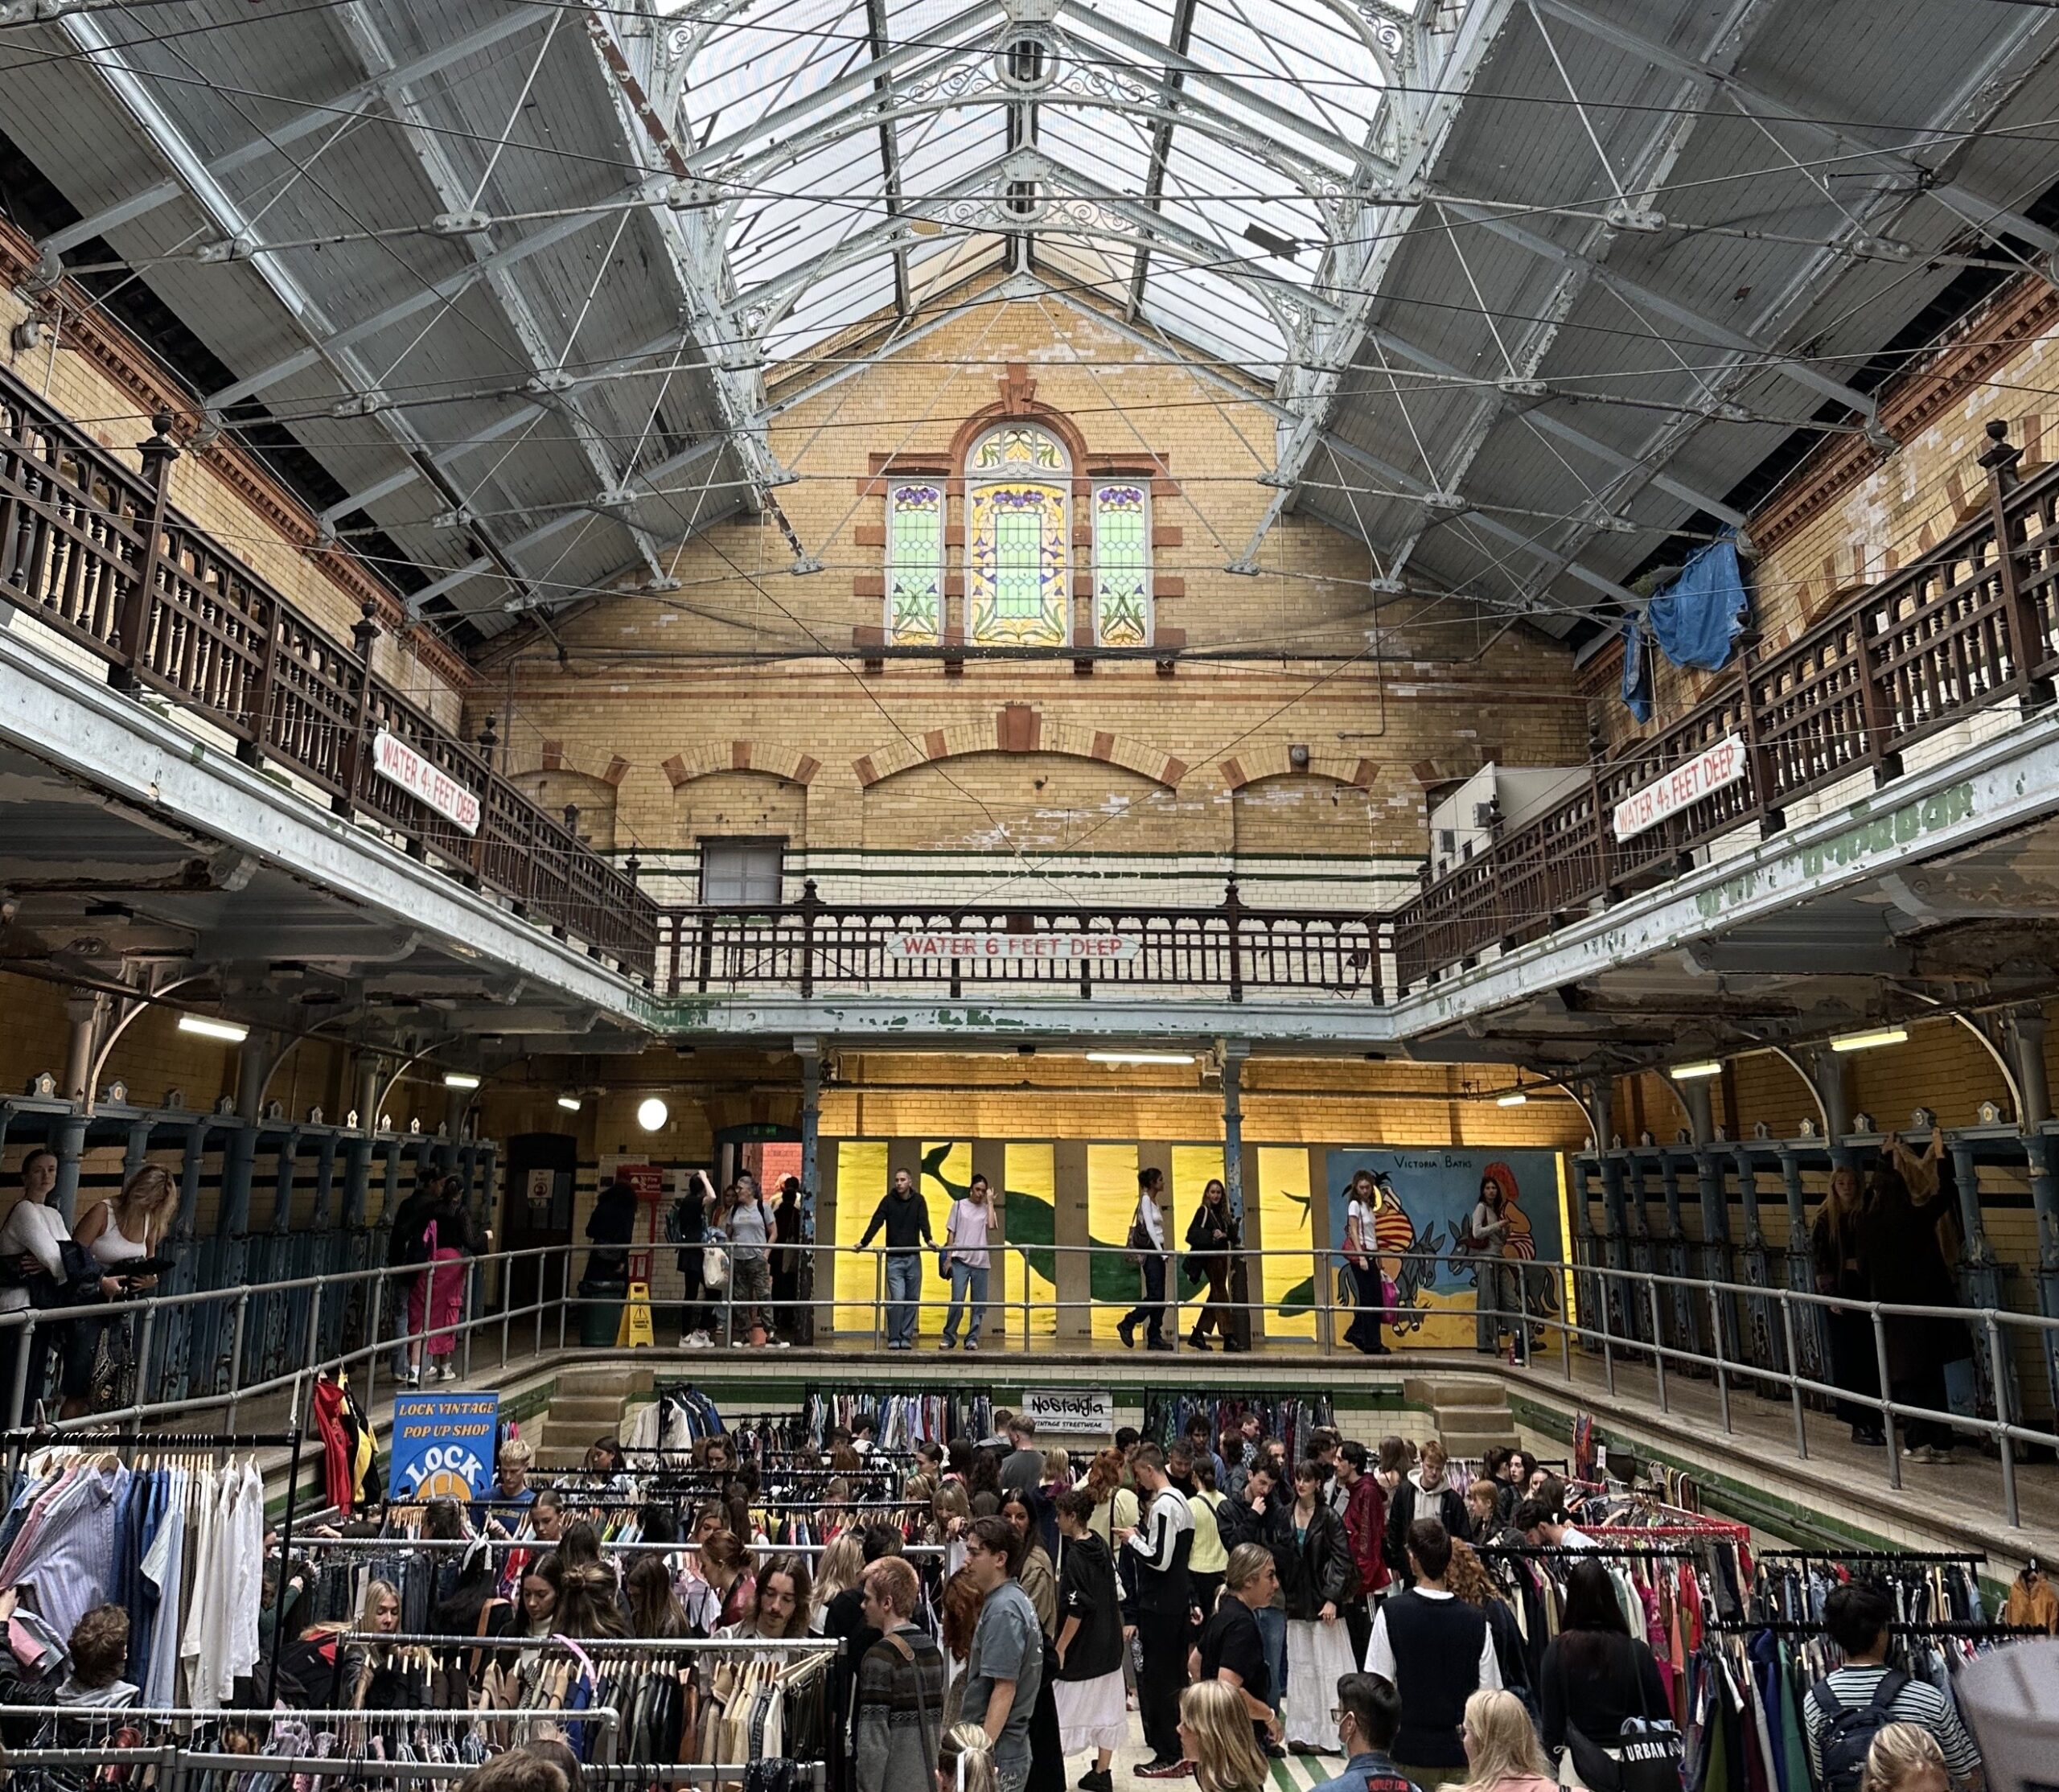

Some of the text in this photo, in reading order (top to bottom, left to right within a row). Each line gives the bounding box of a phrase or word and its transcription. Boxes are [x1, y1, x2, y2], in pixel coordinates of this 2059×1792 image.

[383, 737, 417, 788] WATER
[433, 775, 456, 813] FEET
[455, 791, 476, 826] DEEP
[1618, 792, 1654, 832] WATER
[1671, 762, 1699, 805] FEET
[1703, 743, 1734, 787] DEEP
[902, 937, 1123, 956] WATER 6 FEET DEEP
[398, 1402, 495, 1416] LOCK VINTAGE
[403, 1424, 490, 1439] POP UP SHOP
[405, 1445, 483, 1486] LOCK
[1625, 1742, 1667, 1761] URBAN
